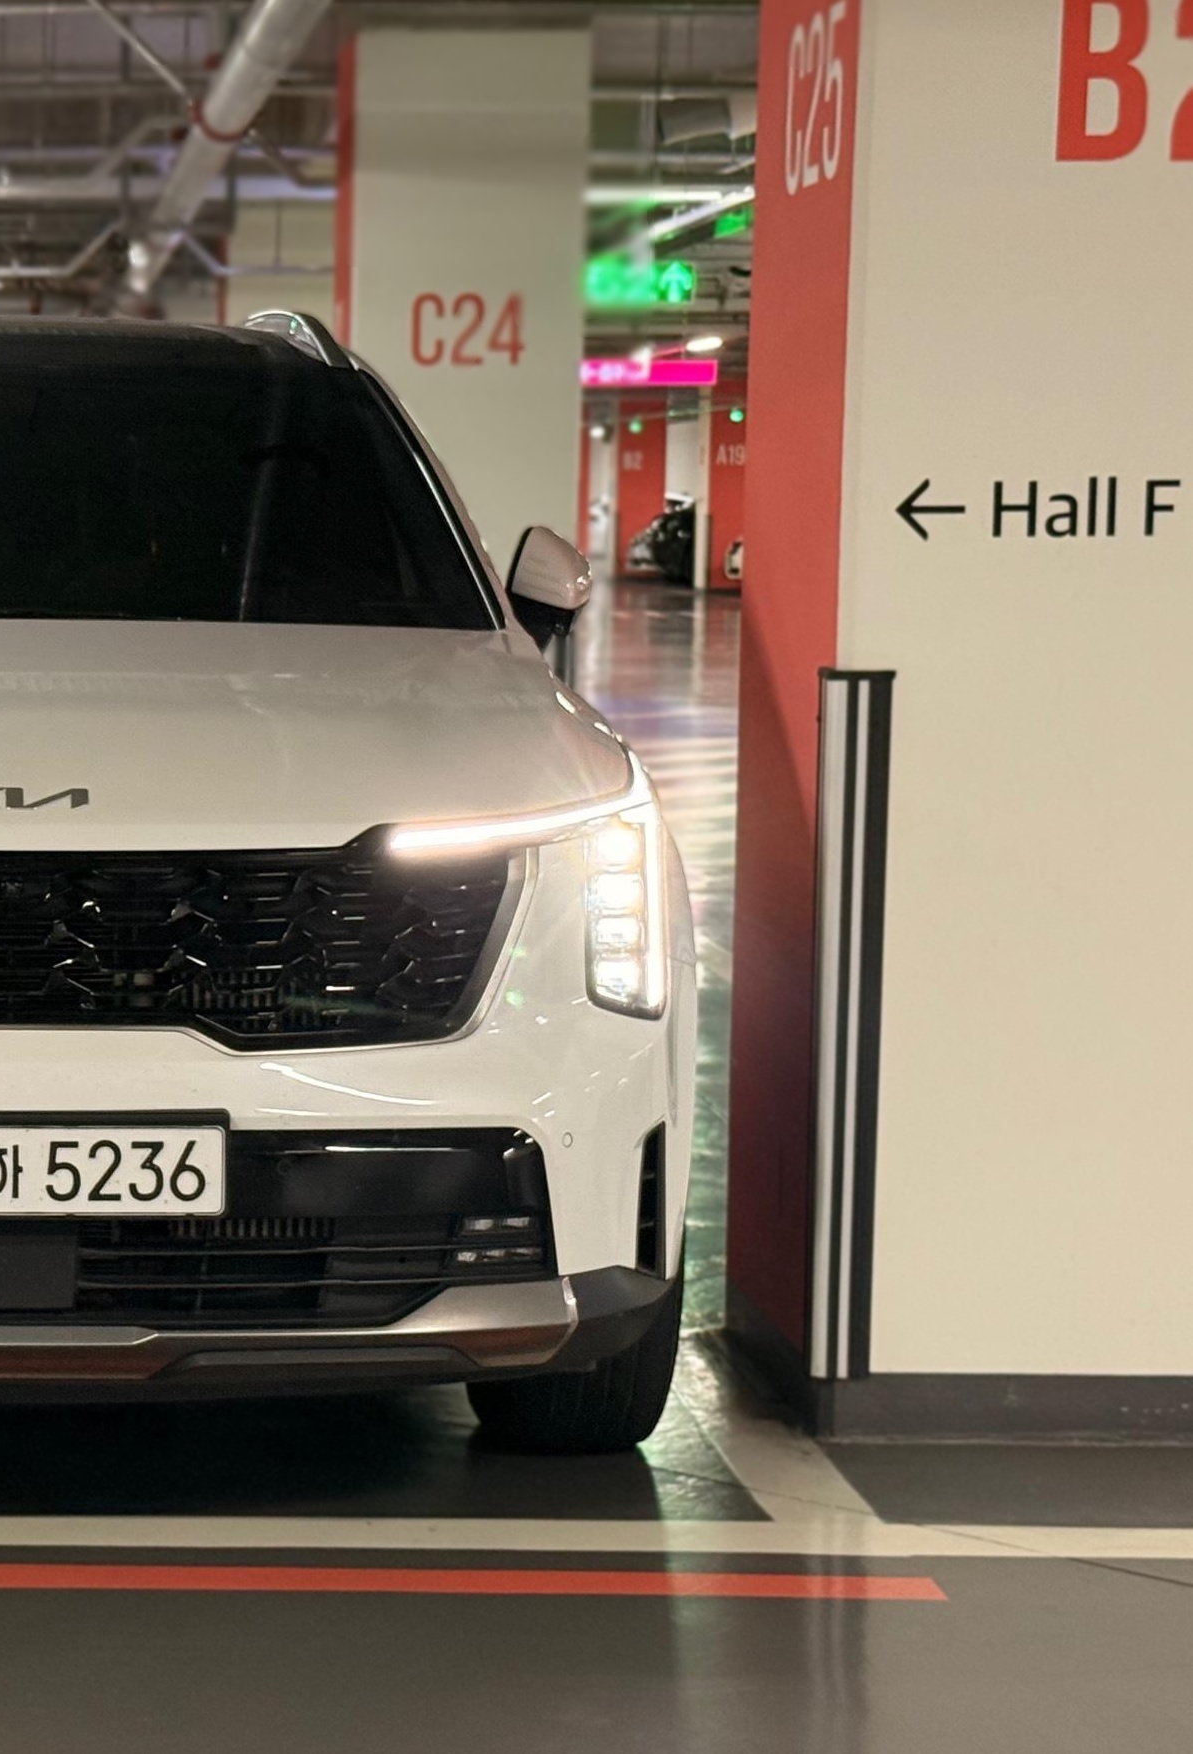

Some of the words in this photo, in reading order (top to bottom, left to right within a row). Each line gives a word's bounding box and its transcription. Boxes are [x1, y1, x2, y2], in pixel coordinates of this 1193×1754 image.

[785, 1, 846, 196] C25
[1055, 0, 1193, 162] B
[411, 292, 524, 366] C24
[715, 445, 746, 466] A19
[991, 476, 1117, 538] Hall
[1144, 479, 1181, 537] F
[45, 1140, 206, 1201] 5236
